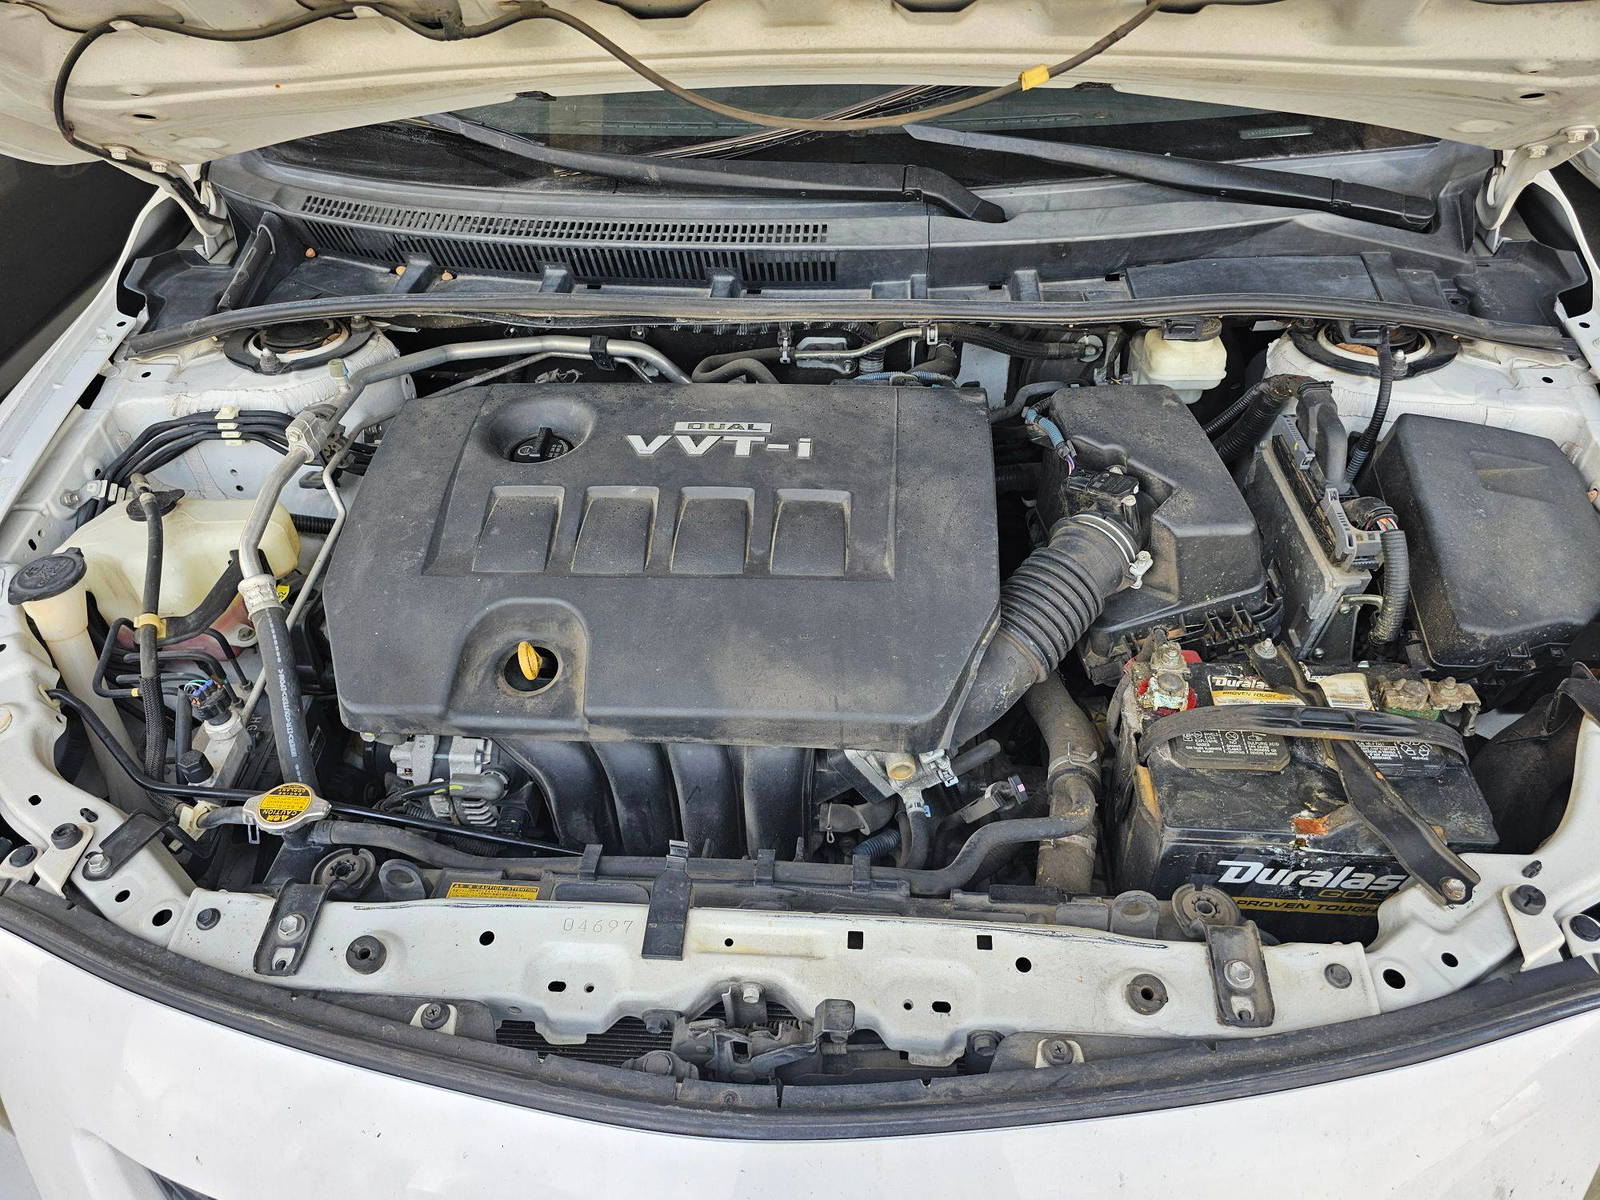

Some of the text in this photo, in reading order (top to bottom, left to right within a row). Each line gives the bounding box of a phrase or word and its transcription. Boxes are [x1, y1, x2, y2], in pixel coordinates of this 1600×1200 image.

[687, 422, 763, 431] DUAL
[625, 434, 811, 458] VVT-i
[1212, 676, 1272, 690] Durala
[262, 808, 298, 816] CAUTION
[1237, 899, 1377, 914] PROVEN TOUGH
[563, 918, 634, 934] 04697
